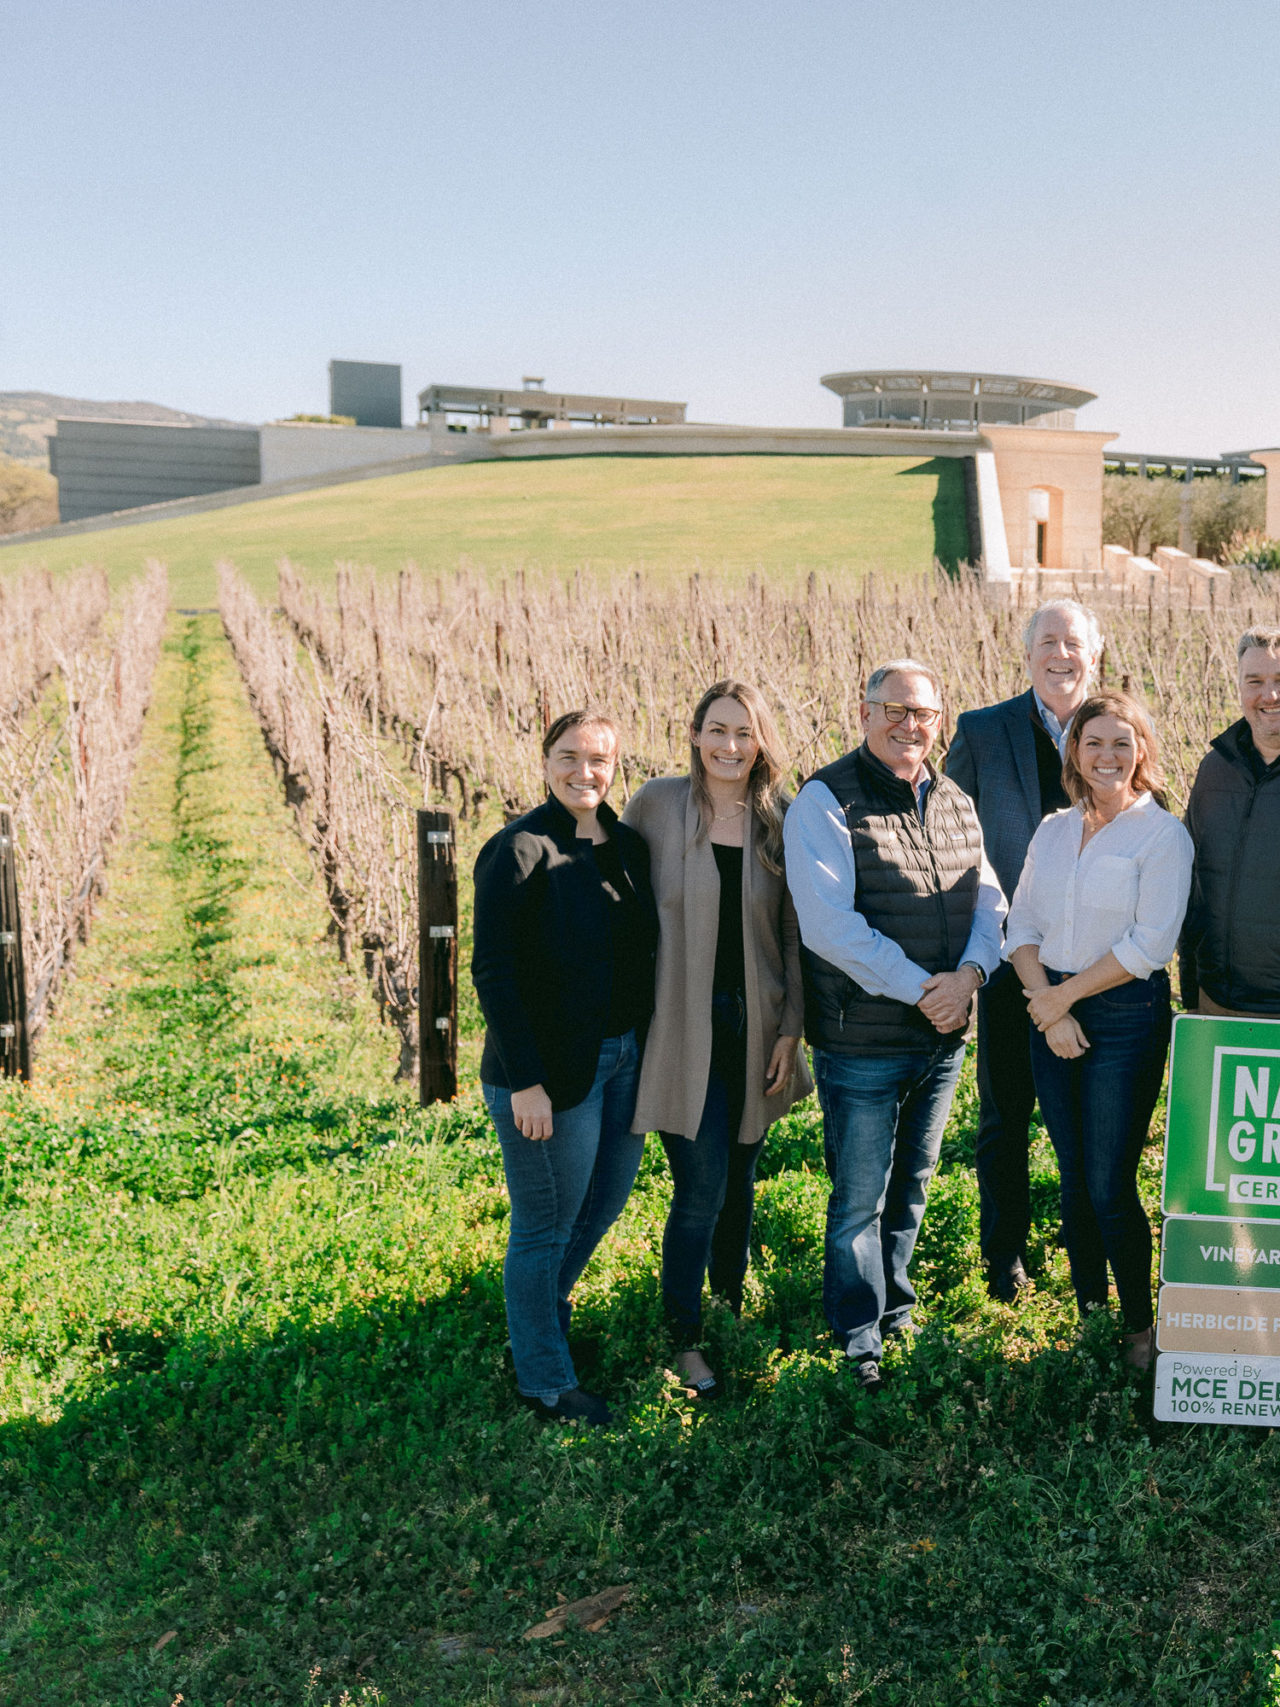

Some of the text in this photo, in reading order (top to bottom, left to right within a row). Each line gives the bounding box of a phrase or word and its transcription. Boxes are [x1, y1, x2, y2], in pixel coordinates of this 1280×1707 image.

[1165, 1312, 1268, 1333] HERBICIDE
[1173, 1362, 1261, 1380] Powered By
[1171, 1377, 1228, 1399] MCE
[1171, 1400, 1216, 1414] 100%
